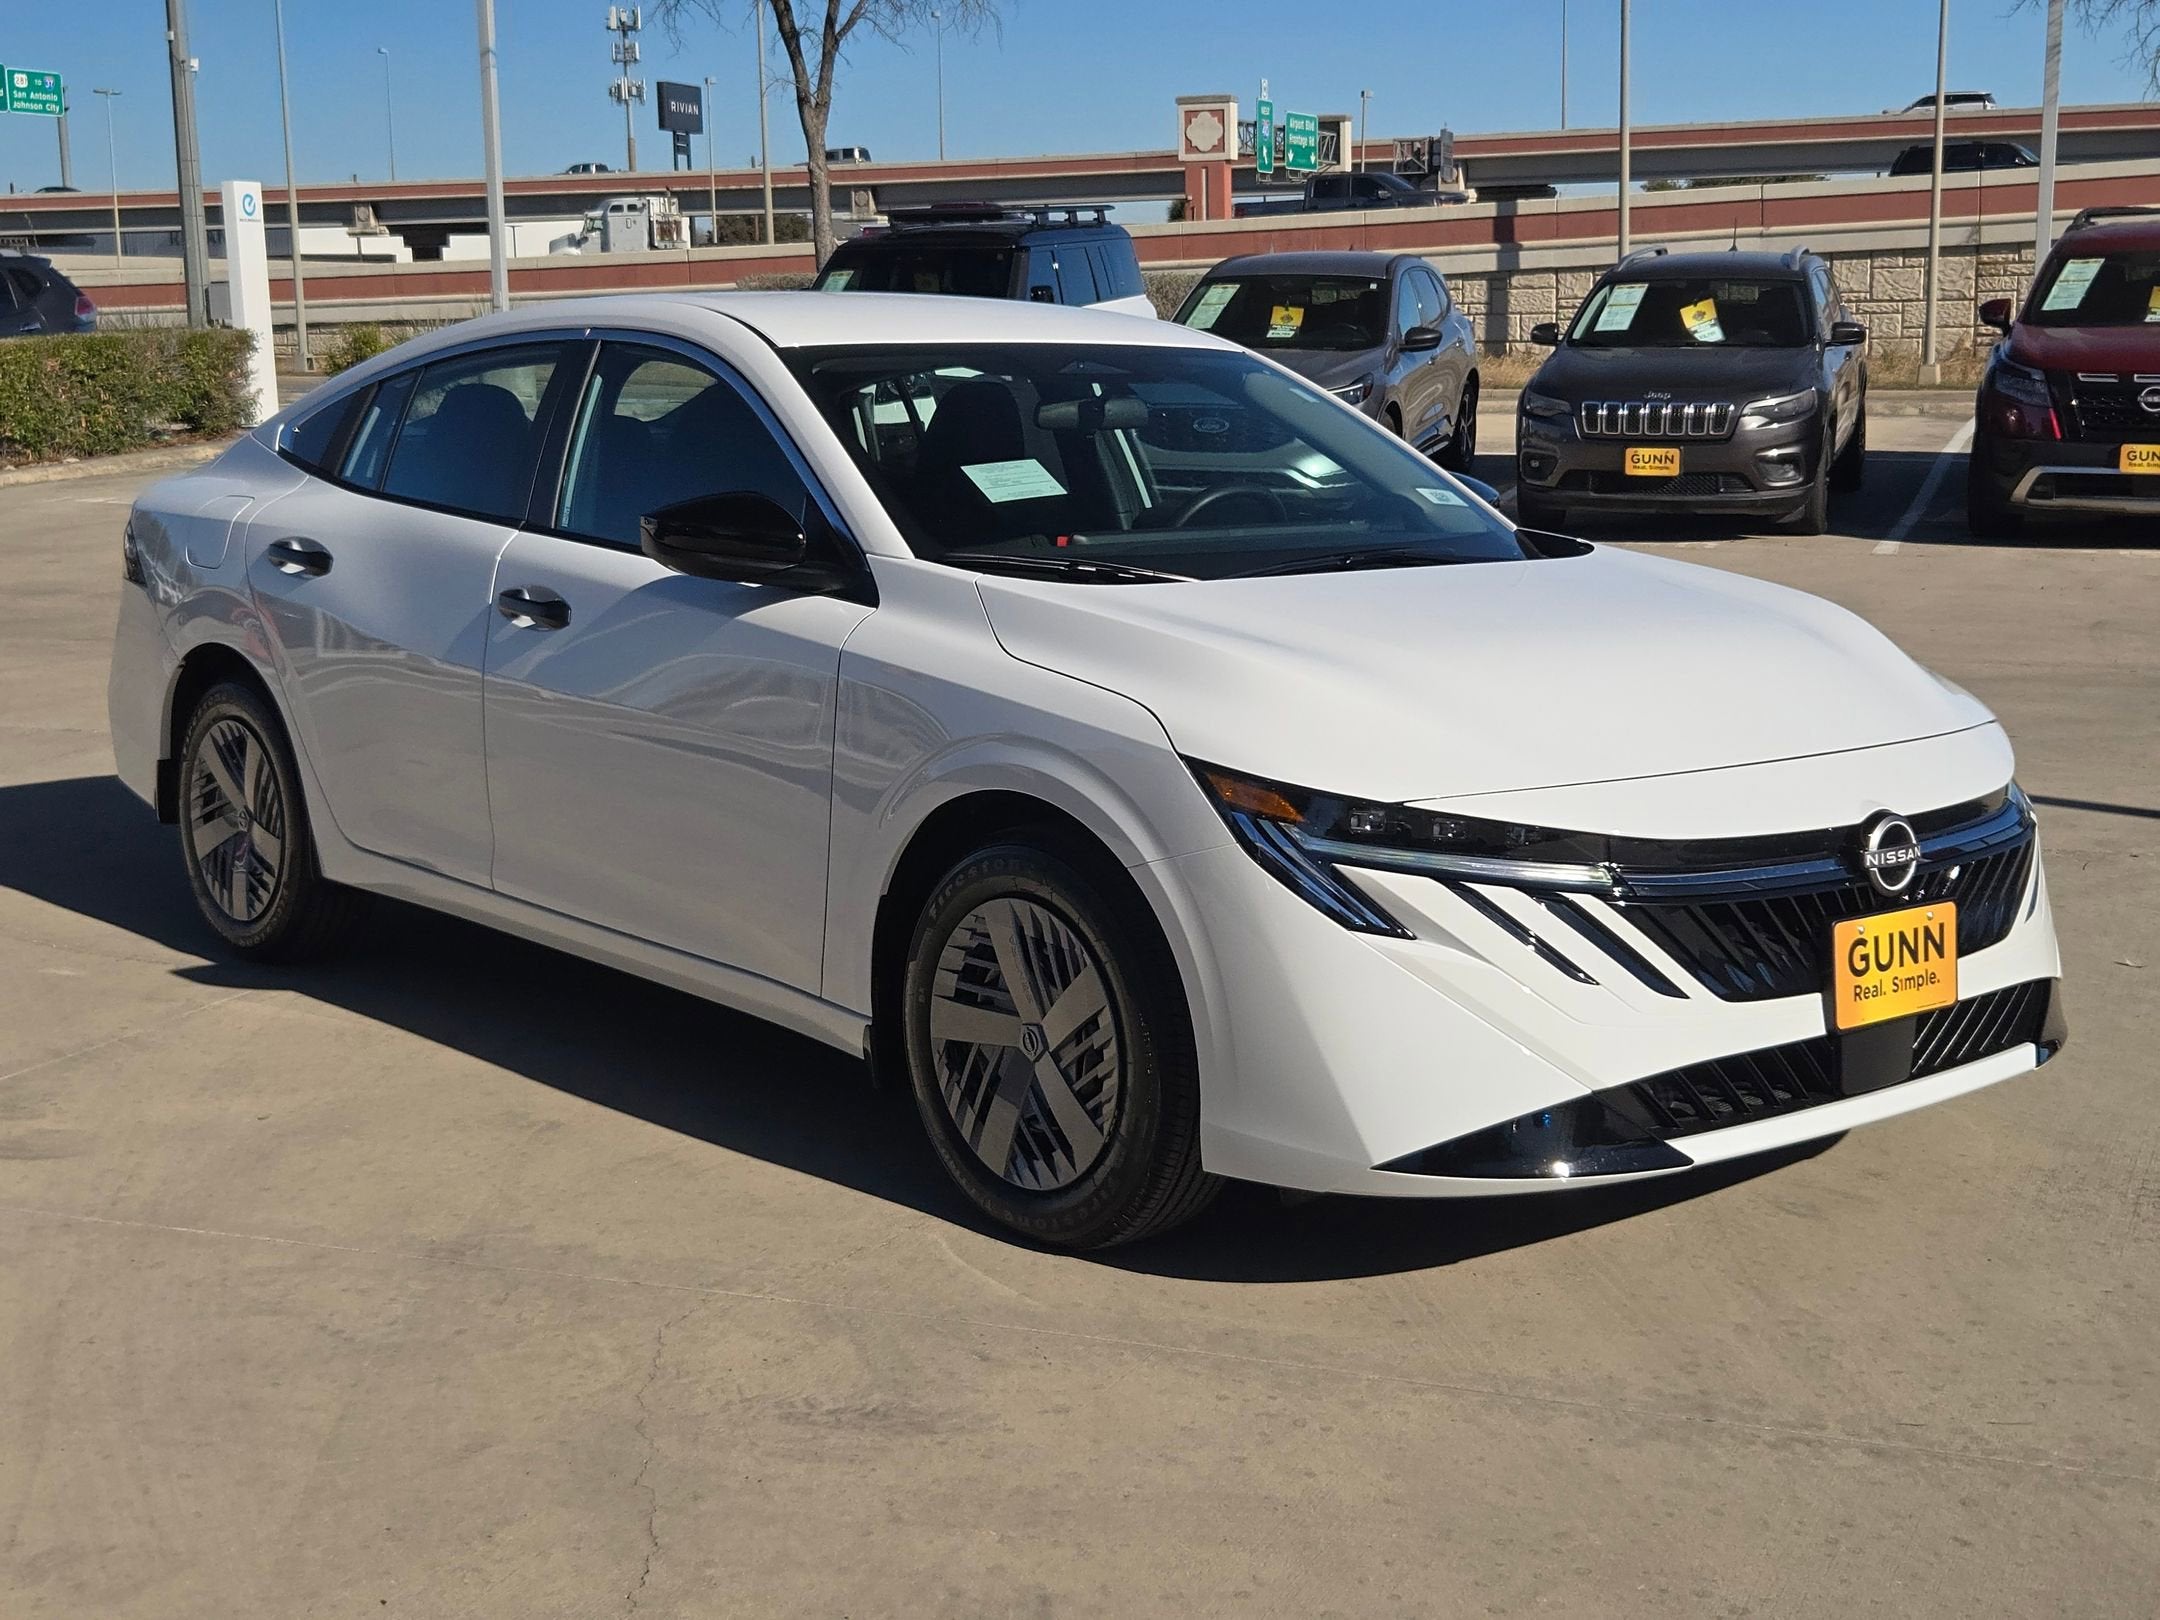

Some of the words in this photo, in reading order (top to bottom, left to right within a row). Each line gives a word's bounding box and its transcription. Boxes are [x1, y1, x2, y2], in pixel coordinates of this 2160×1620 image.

[13, 90, 27, 98] San
[30, 91, 58, 101] Antonio
[13, 101, 43, 110] Johnson
[45, 103, 60, 114] City
[671, 101, 699, 116] RIVIAN
[1289, 117, 1304, 131] Airport
[1305, 120, 1315, 132] Blvd
[1631, 453, 1675, 465] GUNN
[1865, 845, 1921, 866] NISSAN
[1847, 921, 1946, 978] GUNN
[1853, 978, 1887, 1002] Real.
